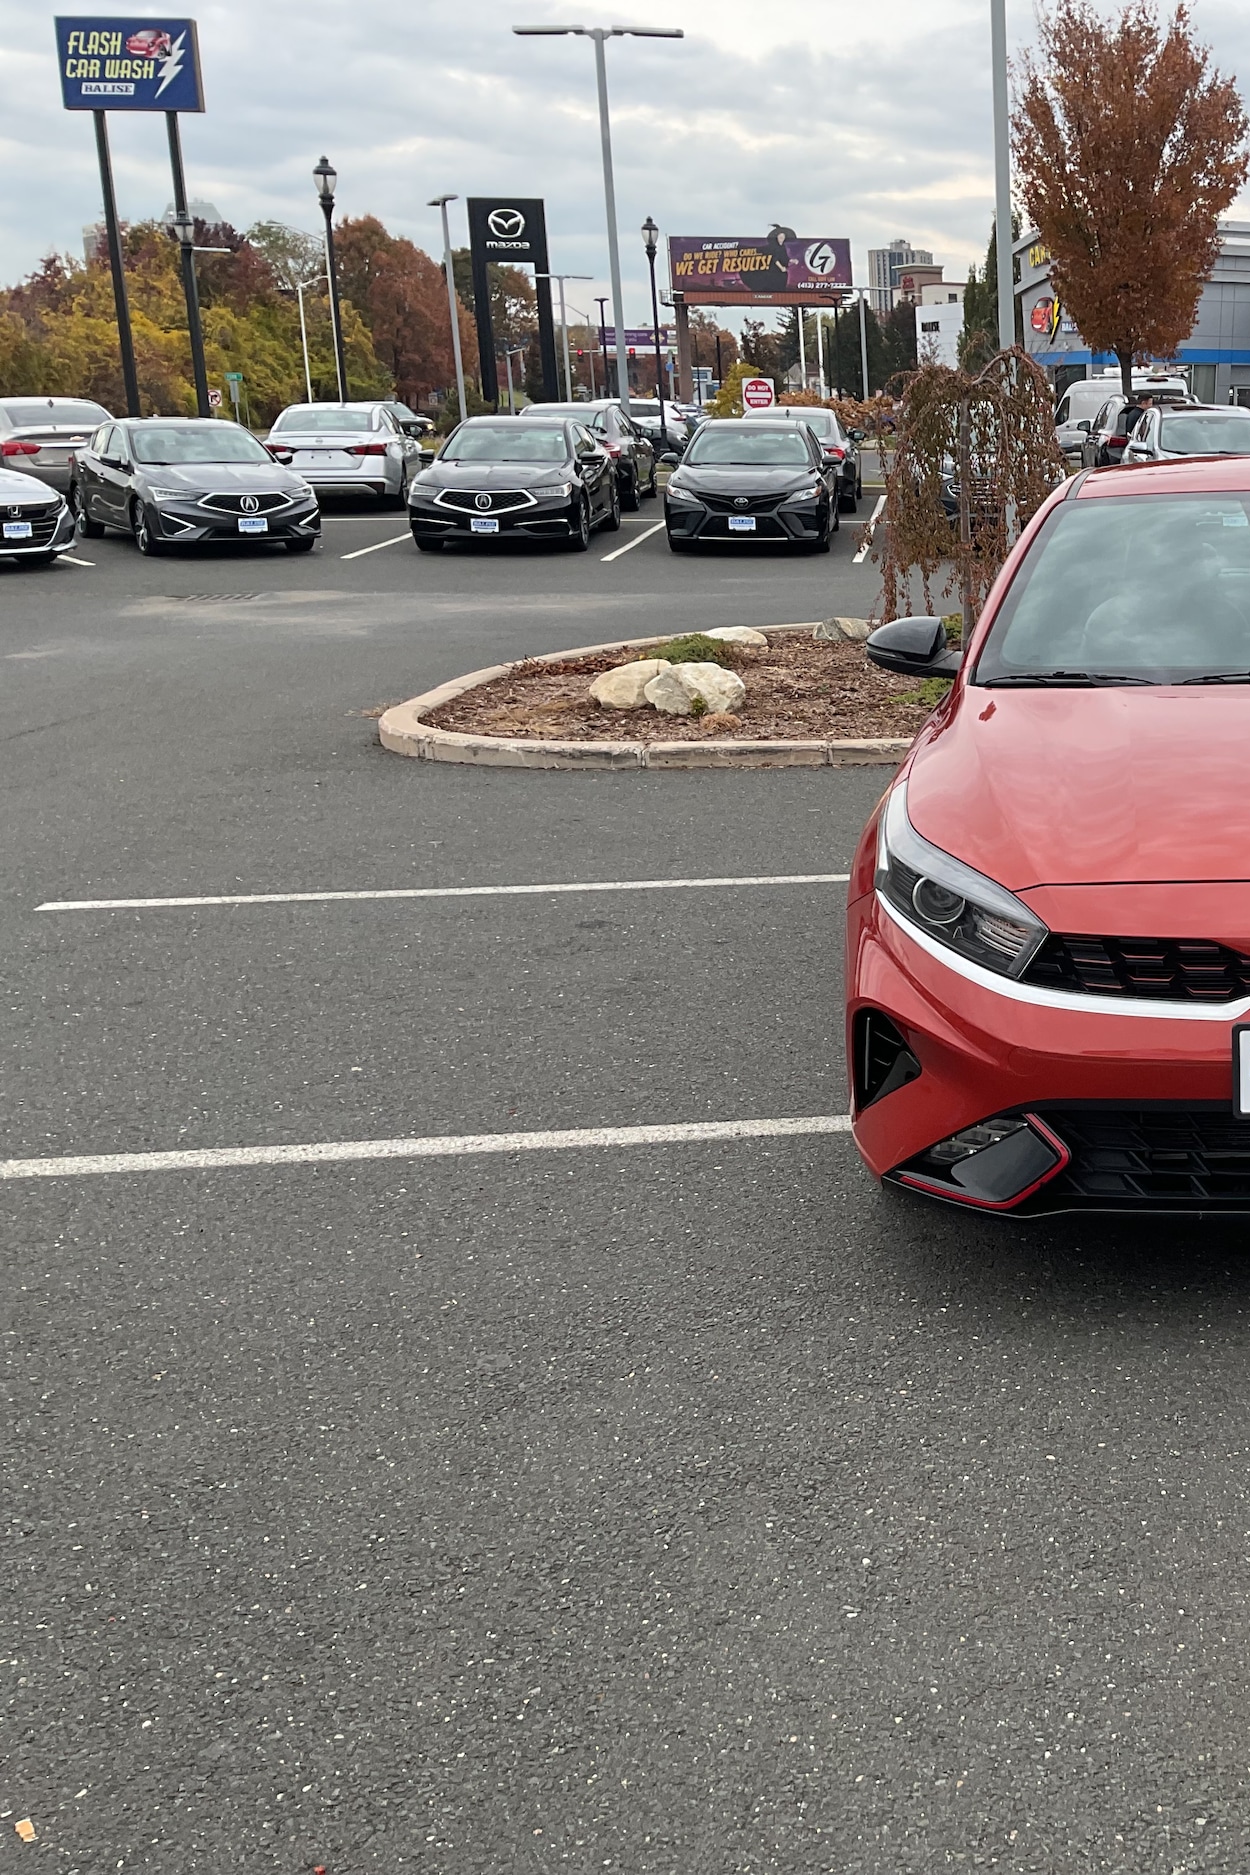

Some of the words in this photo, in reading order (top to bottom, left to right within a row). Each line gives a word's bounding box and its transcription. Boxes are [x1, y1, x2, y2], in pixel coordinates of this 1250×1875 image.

[67, 31, 122, 55] FLASH
[65, 59, 100, 78] CAR
[105, 60, 154, 79] WASH
[83, 84, 133, 93] BALISE
[675, 261, 694, 276] WE
[698, 260, 719, 274] GET
[722, 255, 773, 272] RESULTS!
